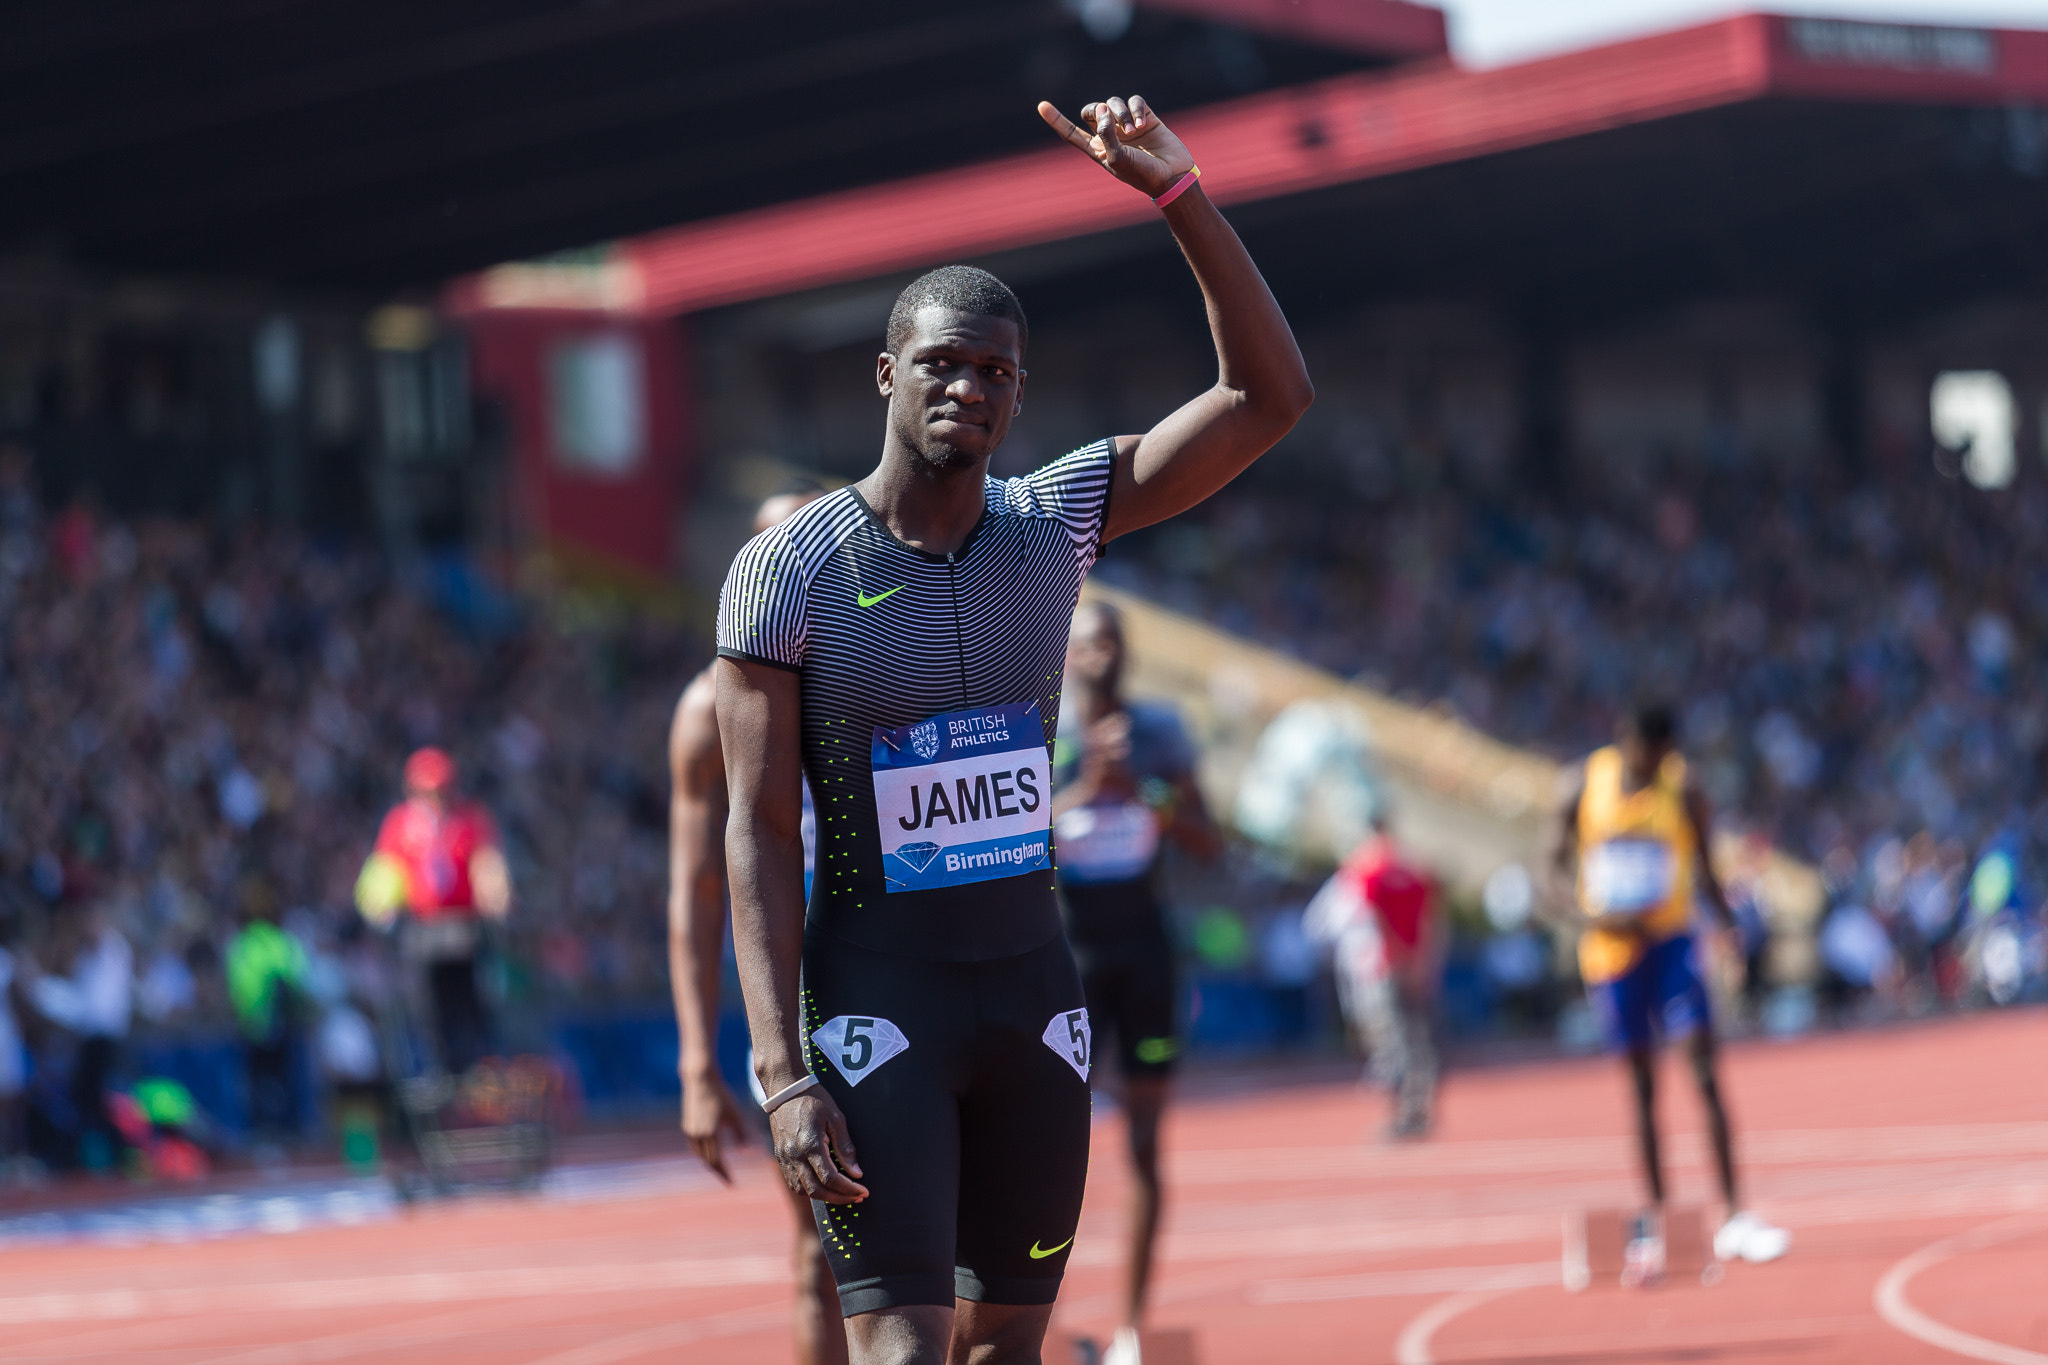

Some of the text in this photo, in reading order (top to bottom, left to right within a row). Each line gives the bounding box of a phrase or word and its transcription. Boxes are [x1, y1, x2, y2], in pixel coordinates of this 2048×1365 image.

[948, 713, 1006, 735] BRITISH
[951, 730, 1010, 749] ATHLETICS
[898, 767, 1040, 831] JAMES
[945, 841, 1045, 872] Birmingham
[841, 1017, 875, 1071] 5
[1065, 1010, 1087, 1067] 5
